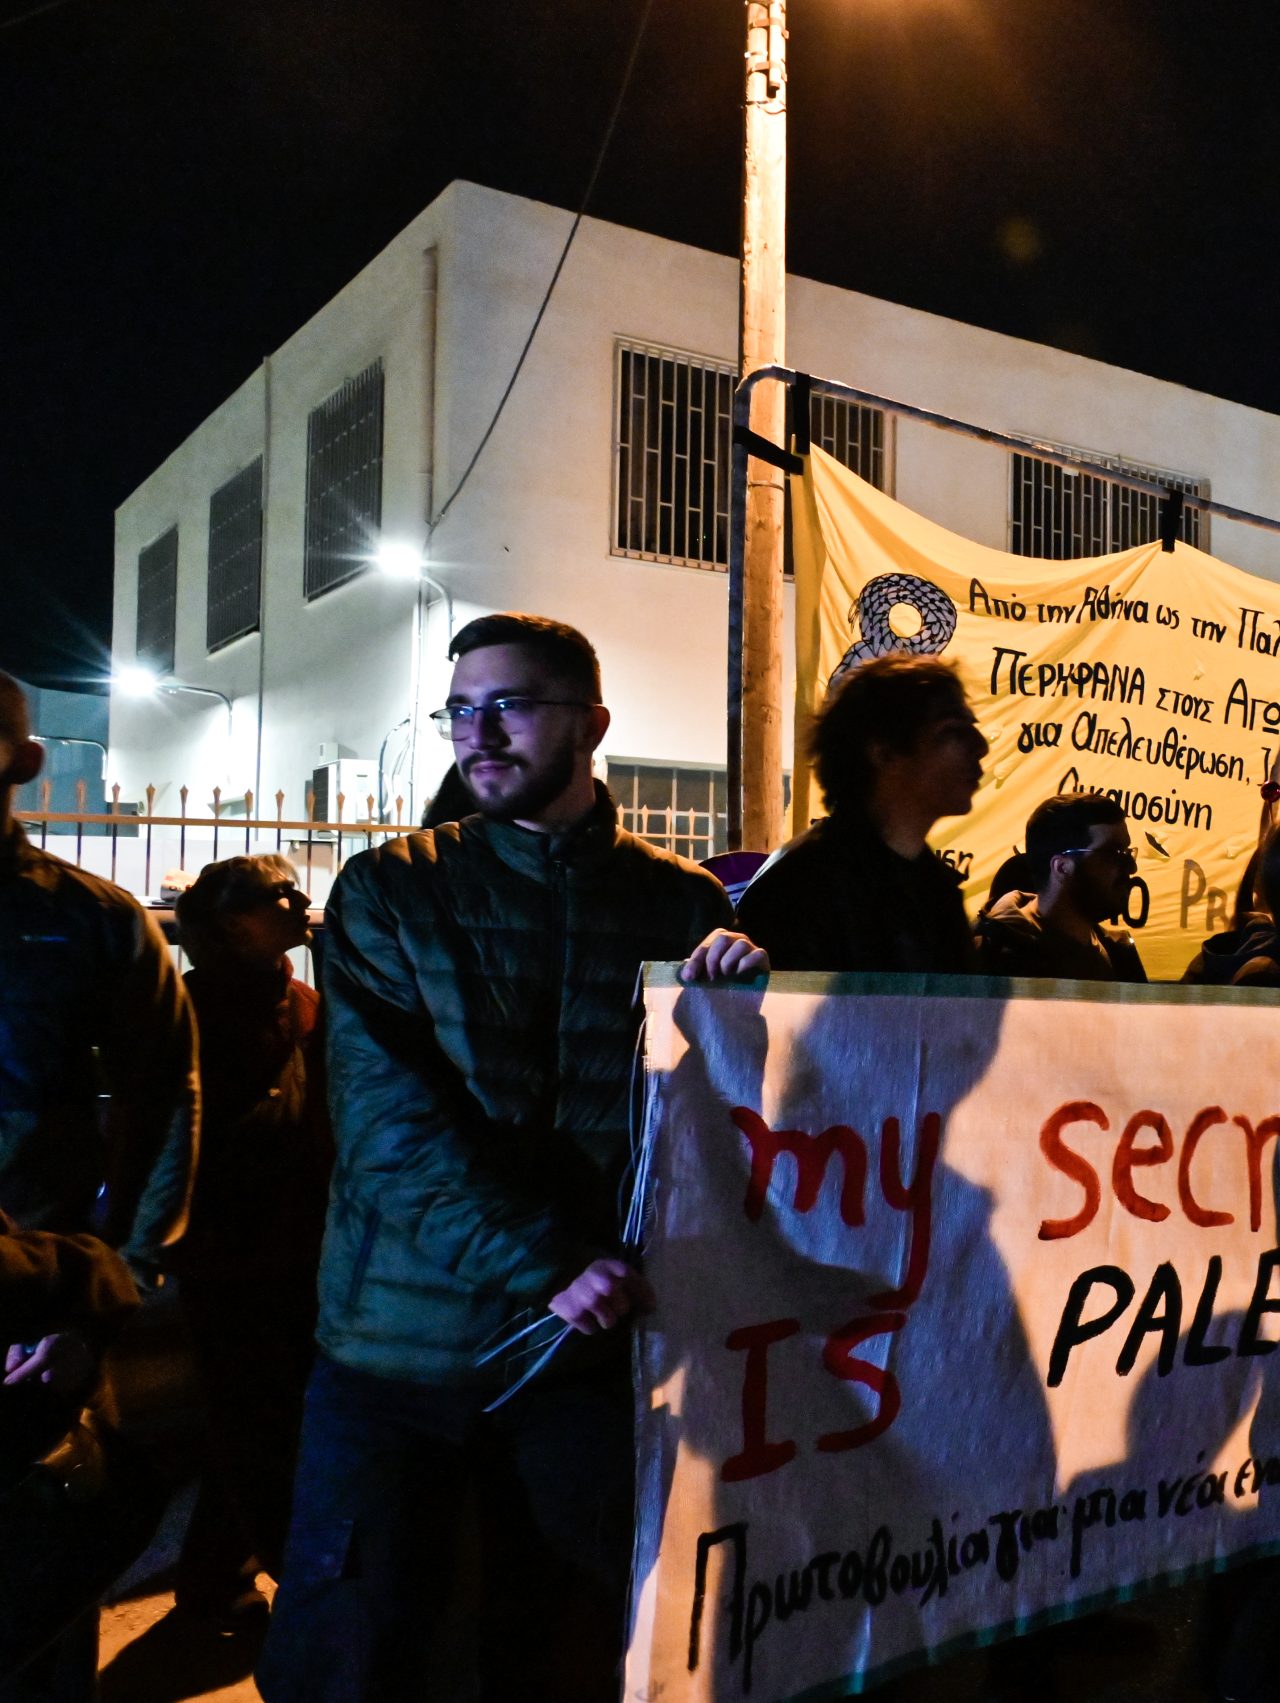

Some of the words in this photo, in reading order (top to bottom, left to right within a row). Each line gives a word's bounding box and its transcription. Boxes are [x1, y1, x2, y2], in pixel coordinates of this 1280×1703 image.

[968, 577, 1026, 622] Από
[1076, 584, 1149, 624] Αθήνα
[1156, 604, 1180, 631] ως
[1191, 615, 1227, 644] την
[1017, 720, 1063, 754] για
[730, 1105, 942, 1312] my
[720, 1310, 908, 1483] IS
[687, 1512, 990, 1695] Πρωτοβουλία
